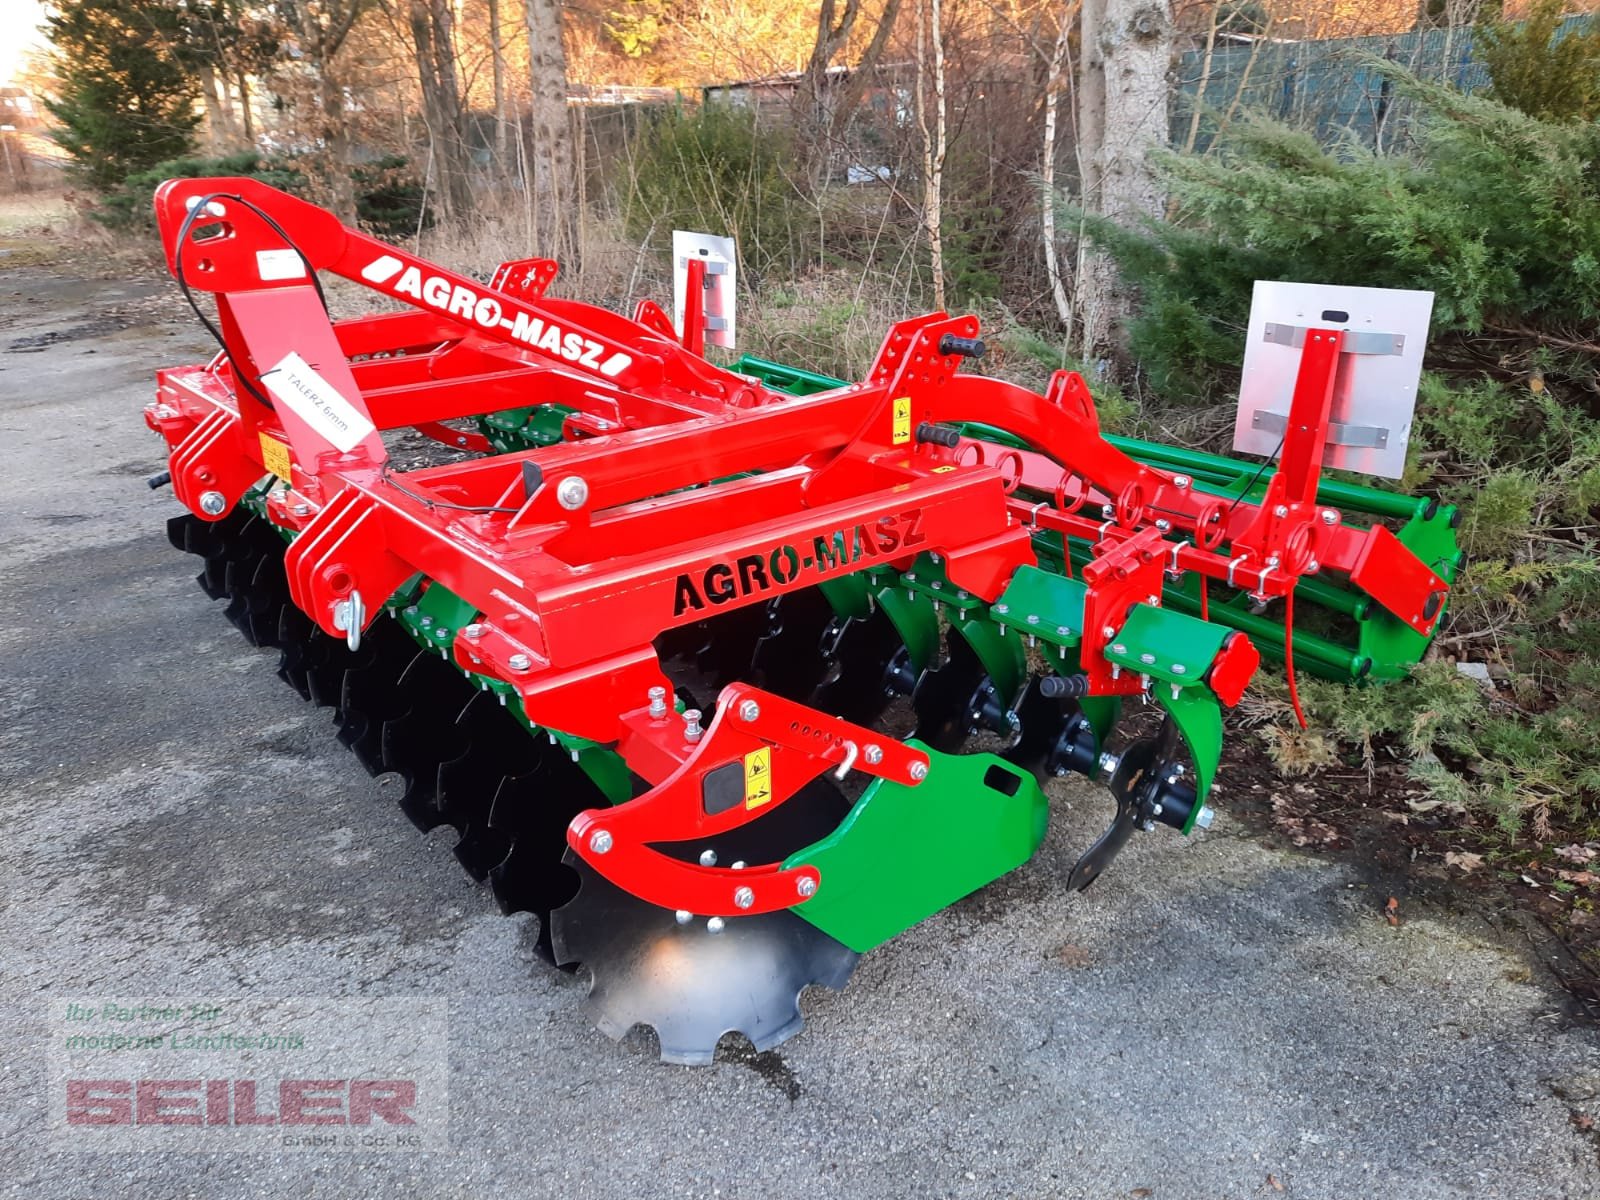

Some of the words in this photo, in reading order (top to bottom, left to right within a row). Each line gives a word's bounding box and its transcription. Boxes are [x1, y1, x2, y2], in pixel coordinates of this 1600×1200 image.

[394, 265, 604, 370] AGRO-MASZ
[287, 373, 325, 408] TALERZ
[322, 405, 349, 432] 6mm
[673, 508, 926, 618] AGRO-MASZ
